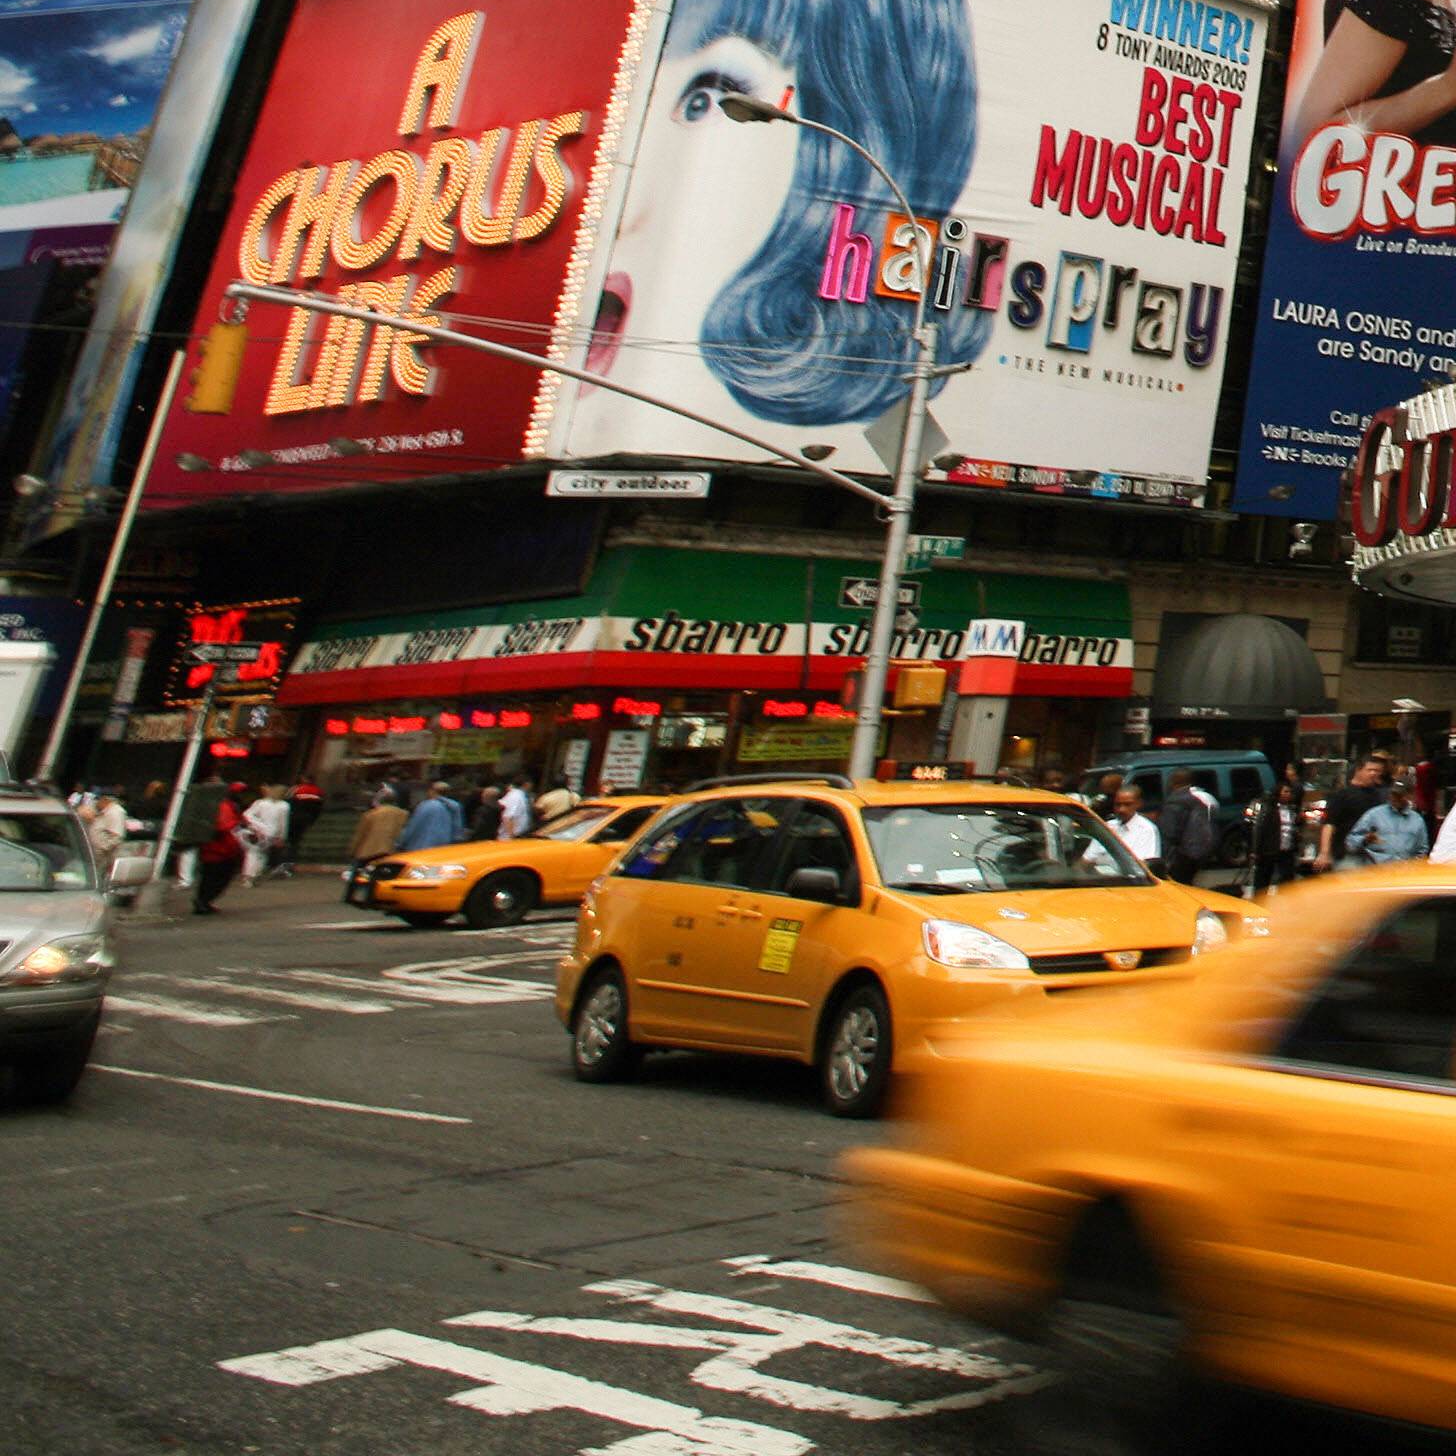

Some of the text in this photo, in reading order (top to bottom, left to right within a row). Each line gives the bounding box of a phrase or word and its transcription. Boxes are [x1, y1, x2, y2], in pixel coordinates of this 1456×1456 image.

[397, 9, 486, 137] A
[1115, 32, 1152, 62] TONY
[1212, 62, 1247, 91] 2003
[1134, 66, 1243, 168] BEST
[239, 110, 592, 287] CHORUS
[1030, 123, 1226, 247] MUSICAL
[1356, 234, 1384, 252] Live
[818, 202, 1223, 369] hairspray
[264, 265, 459, 417] LINE
[1272, 298, 1340, 330] LAURA
[1346, 311, 1412, 341] OSNES
[1317, 337, 1355, 359] are
[1358, 339, 1425, 373] Sandy
[1102, 367, 1176, 392] MUSICAL
[1260, 422, 1287, 442] Visit
[1330, 408, 1359, 428] Call
[1301, 447, 1348, 469] Brooks
[571, 474, 692, 493] city outdoor
[624, 610, 788, 654] sbarro
[825, 620, 965, 660] sbrro
